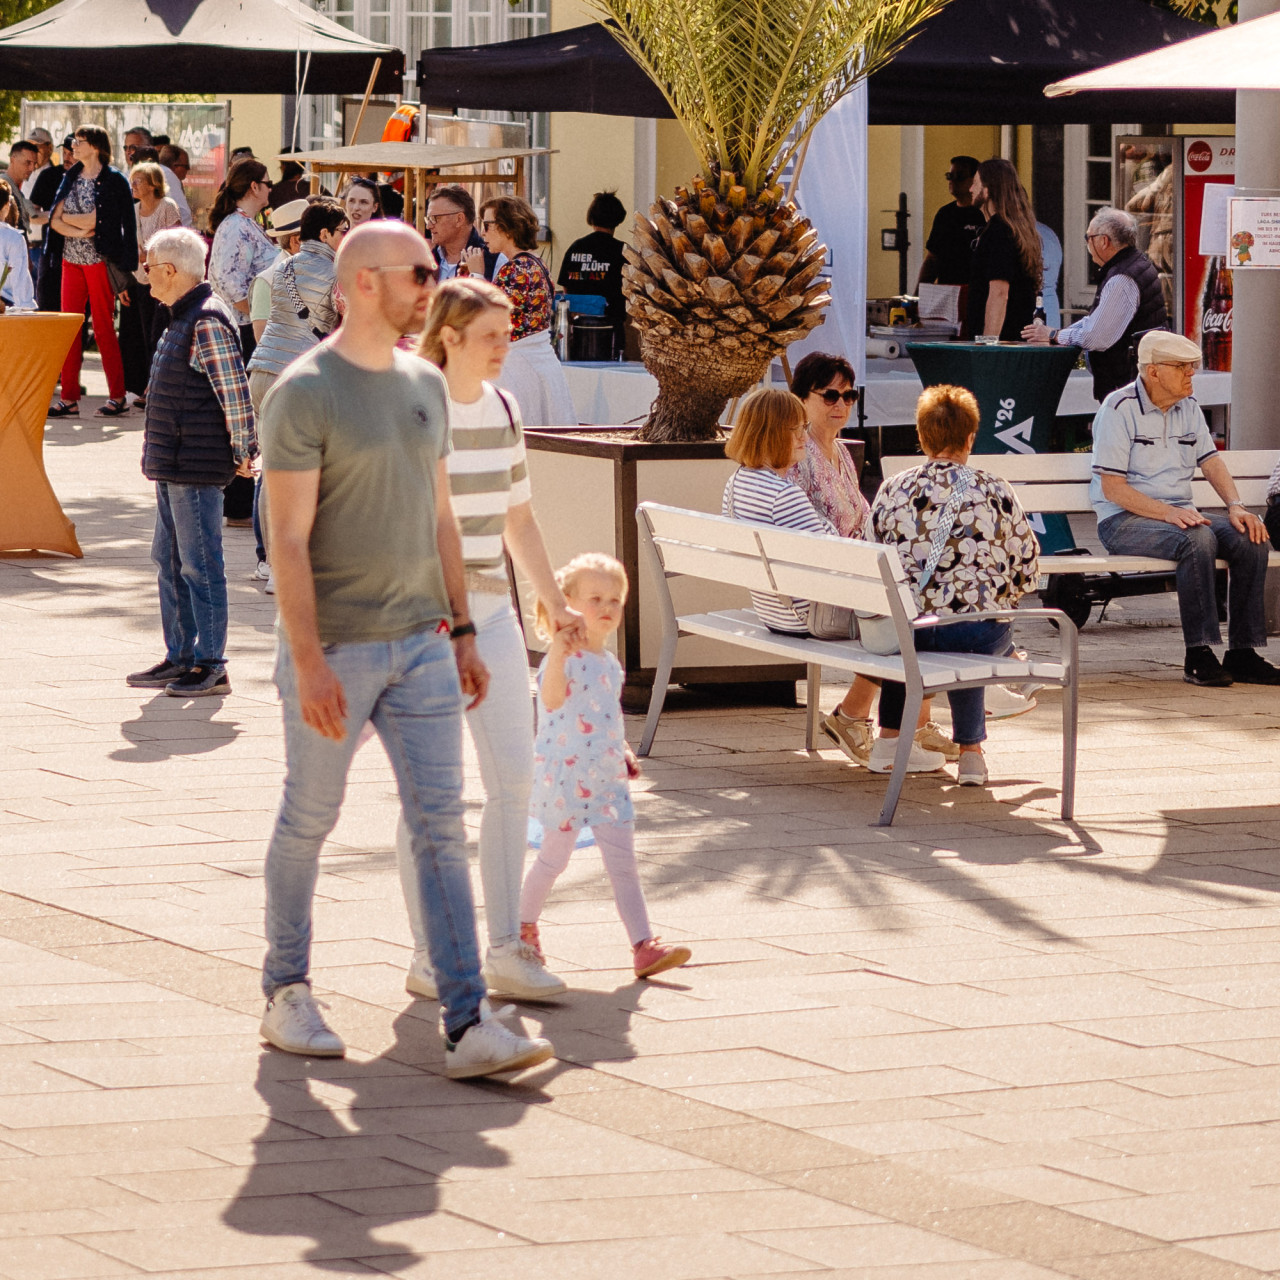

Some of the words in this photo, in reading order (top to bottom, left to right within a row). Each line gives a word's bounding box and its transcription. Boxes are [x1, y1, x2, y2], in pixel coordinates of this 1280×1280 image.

[571, 253, 592, 262] HIER
[581, 260, 610, 271] BLÜHT
[568, 271, 606, 280] VIELALT
